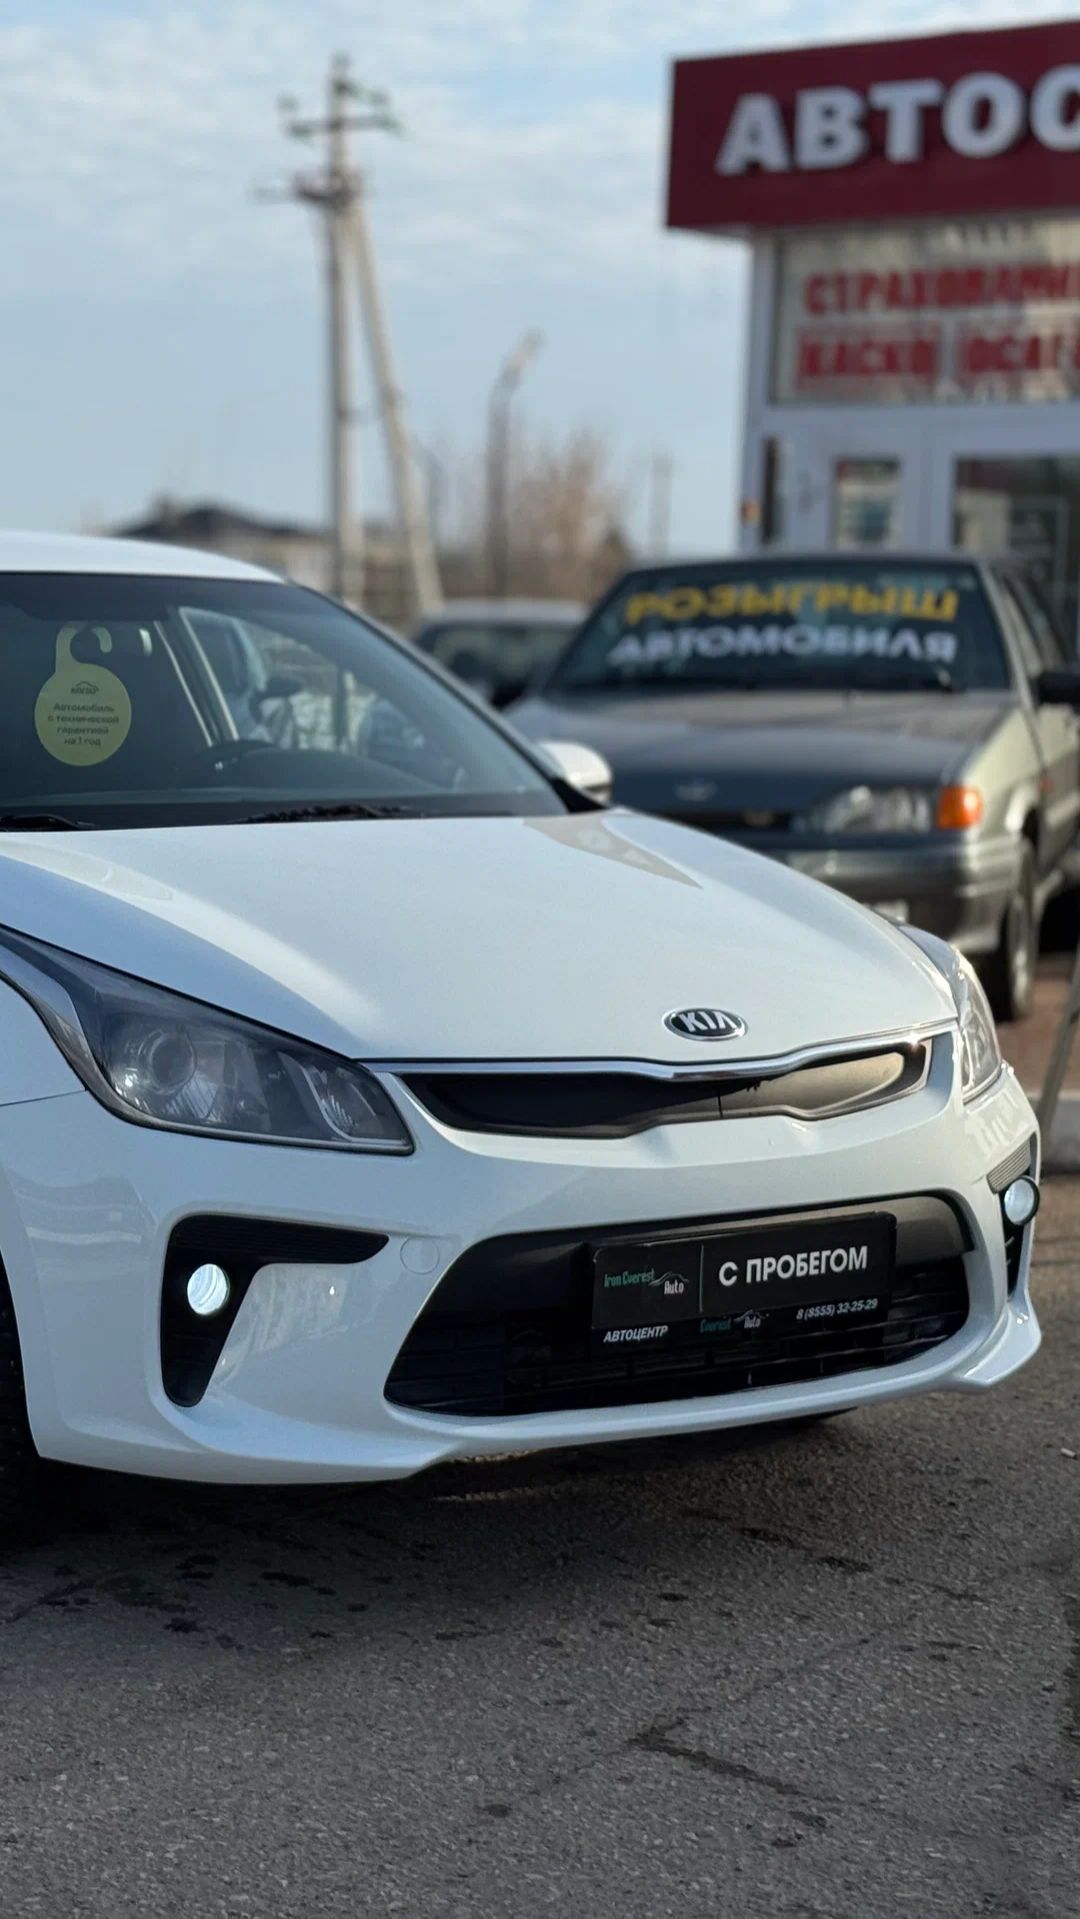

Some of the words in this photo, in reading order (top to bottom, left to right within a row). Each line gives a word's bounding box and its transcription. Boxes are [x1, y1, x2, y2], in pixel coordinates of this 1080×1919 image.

[625, 584, 958, 625] РОЗЫГРЫШ
[607, 624, 957, 666] АВТОМОБИЛЯ
[53, 702, 115, 712] Автомобиль
[678, 1011, 737, 1032] KIA
[718, 1261, 738, 1287] С
[746, 1245, 868, 1284] ПРОБЕГОМ
[604, 1273, 622, 1288] Iron
[664, 1280, 684, 1295] Auto
[804, 1303, 835, 1320] (8555)
[836, 1298, 878, 1314] 32-25-29
[603, 1325, 669, 1343] АВТОЦЕНТР
